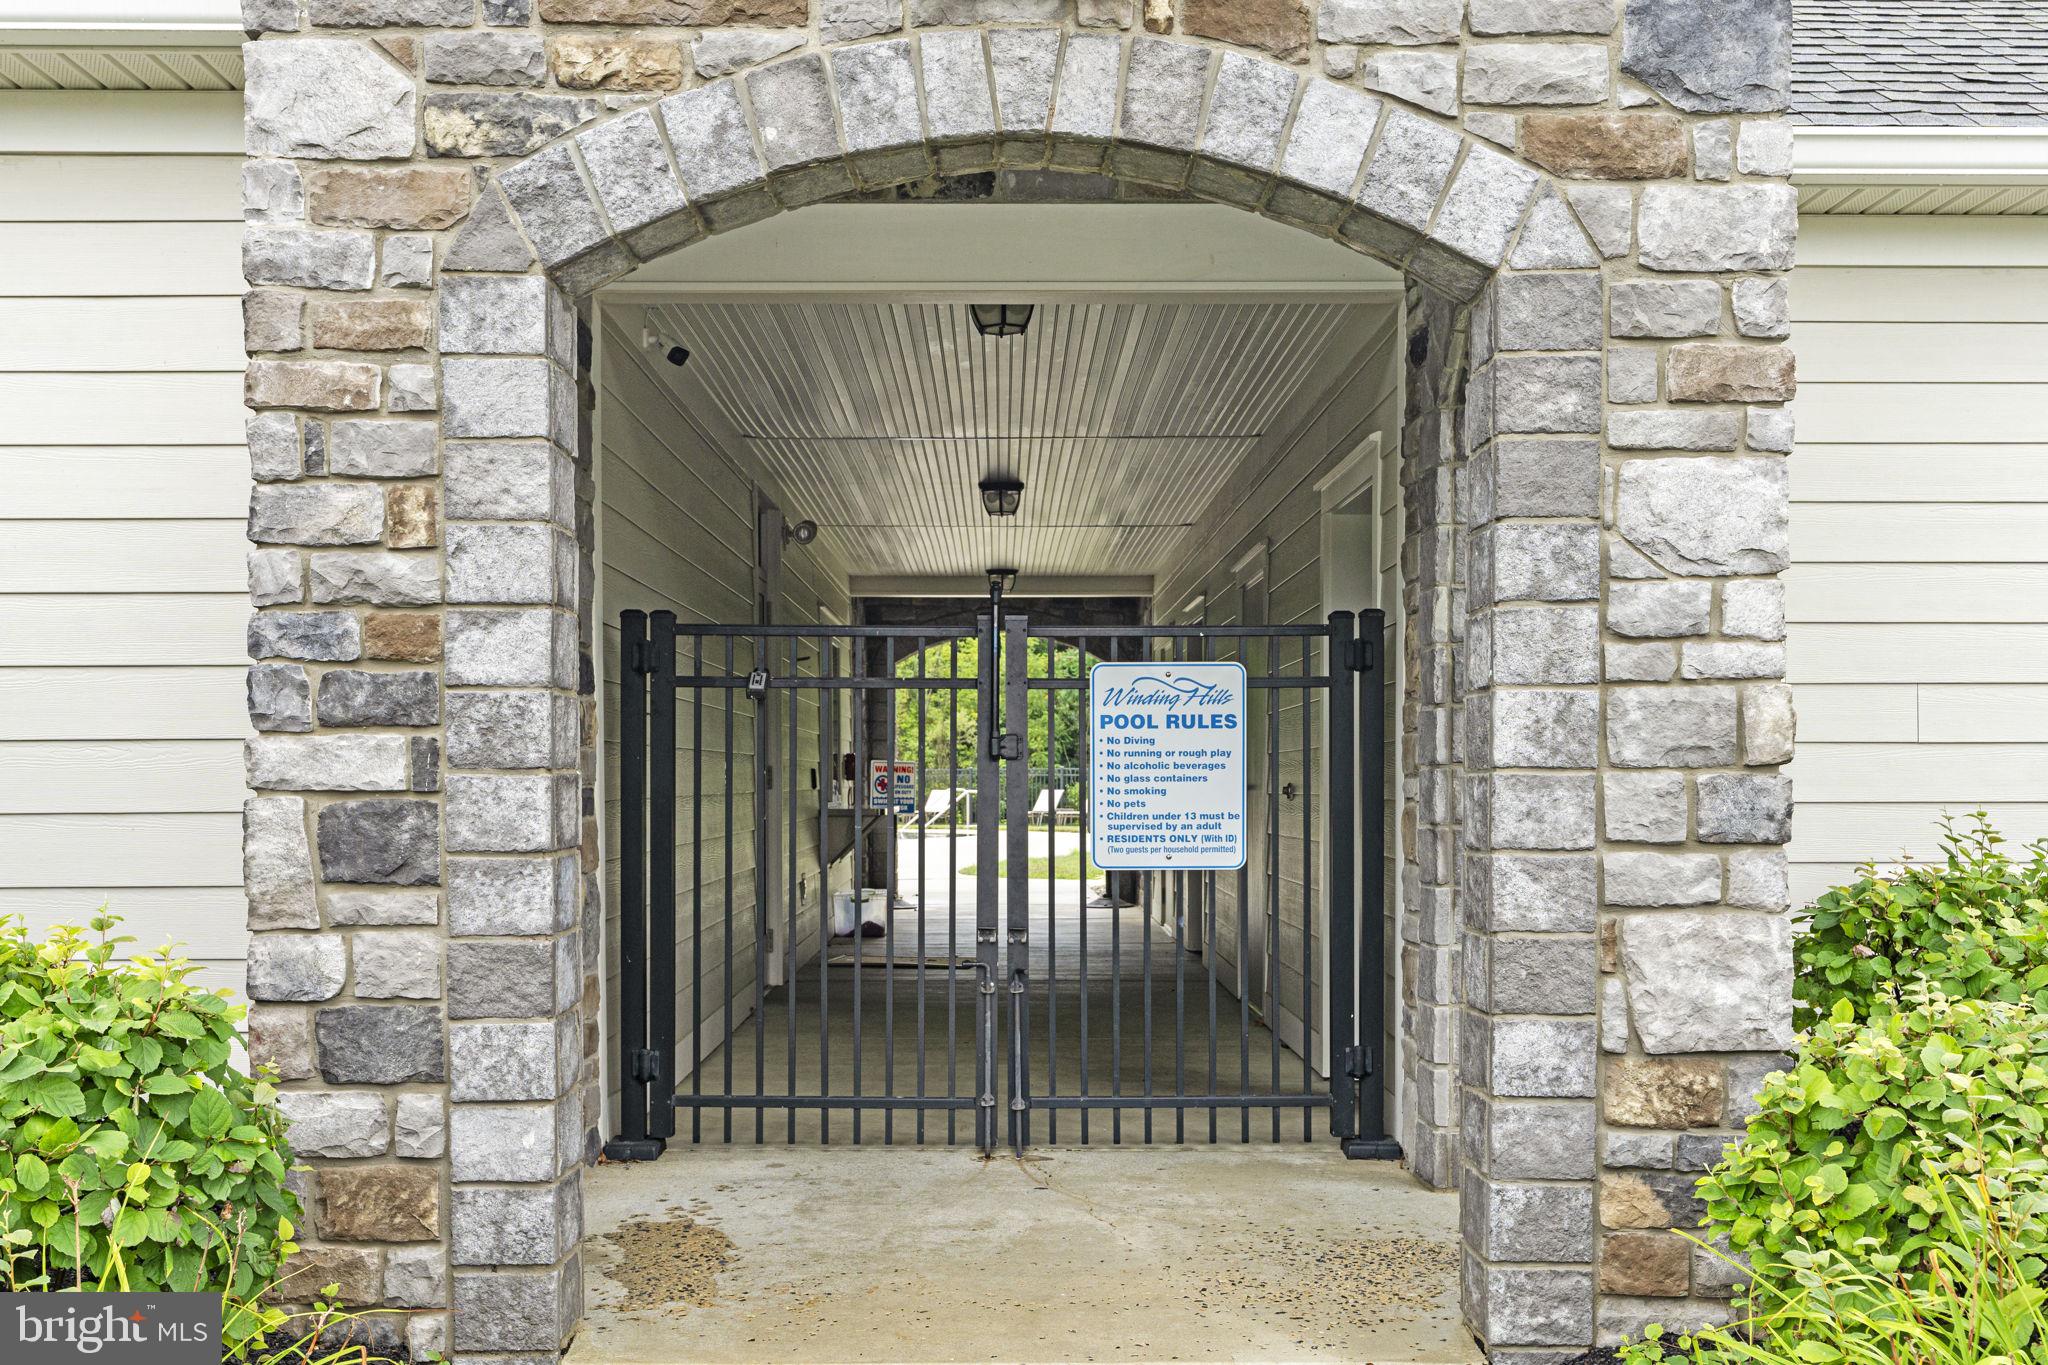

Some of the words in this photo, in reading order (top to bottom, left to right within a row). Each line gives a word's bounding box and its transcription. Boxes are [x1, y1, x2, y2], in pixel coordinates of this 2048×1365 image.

[1103, 687, 1181, 711] Winding
[1184, 681, 1235, 705] Hills
[1100, 714, 1158, 729] POOL
[1166, 714, 1237, 729] RULES
[1124, 736, 1155, 745] Diving
[1124, 750, 1162, 759] running
[1179, 749, 1207, 759] rough
[1210, 749, 1232, 759] play
[875, 765, 914, 773] WANING!
[1173, 762, 1226, 771] beverages
[897, 775, 910, 783] NO
[1124, 775, 1150, 783] glass
[1124, 787, 1167, 796] smoking
[1124, 801, 1146, 809] pets
[1107, 812, 1148, 820] Children
[1152, 812, 1181, 820] under
[1185, 812, 1196, 820] 13
[1108, 823, 1162, 831] supervised
[1166, 822, 1177, 831] by
[1196, 822, 1221, 830] adult
[1201, 835, 1222, 843] (With
[1225, 835, 1237, 843] ID)
[1107, 845, 1123, 854] (Two
[1126, 846, 1148, 854] guests
[1201, 845, 1236, 854] permitted)
